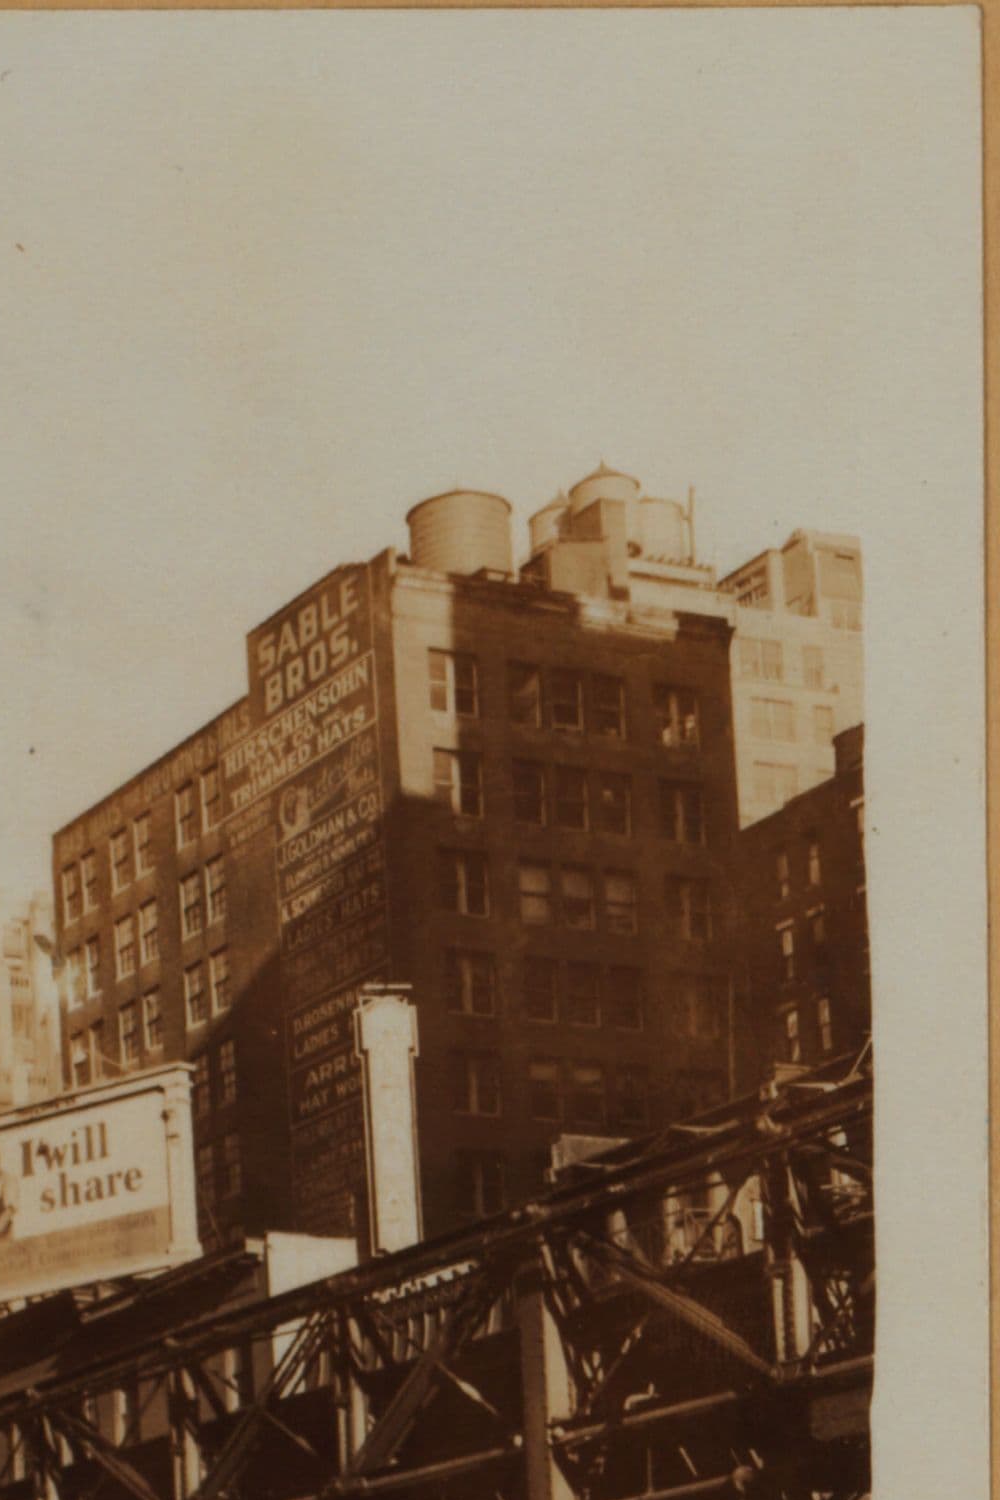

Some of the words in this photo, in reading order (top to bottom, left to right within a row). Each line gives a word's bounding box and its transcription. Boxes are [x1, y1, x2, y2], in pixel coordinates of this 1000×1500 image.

[257, 573, 360, 677] SABLE
[264, 624, 360, 714] BROS.
[225, 658, 370, 779] HIRSCHENSOHN
[229, 747, 312, 810] TRIMMED
[317, 705, 366, 749] HATS
[249, 741, 287, 777] HAT
[341, 882, 380, 920] HATS
[299, 1088, 329, 1114] HAT
[20, 1138, 36, 1179] I
[38, 1120, 109, 1172] will
[39, 1164, 143, 1213] share
